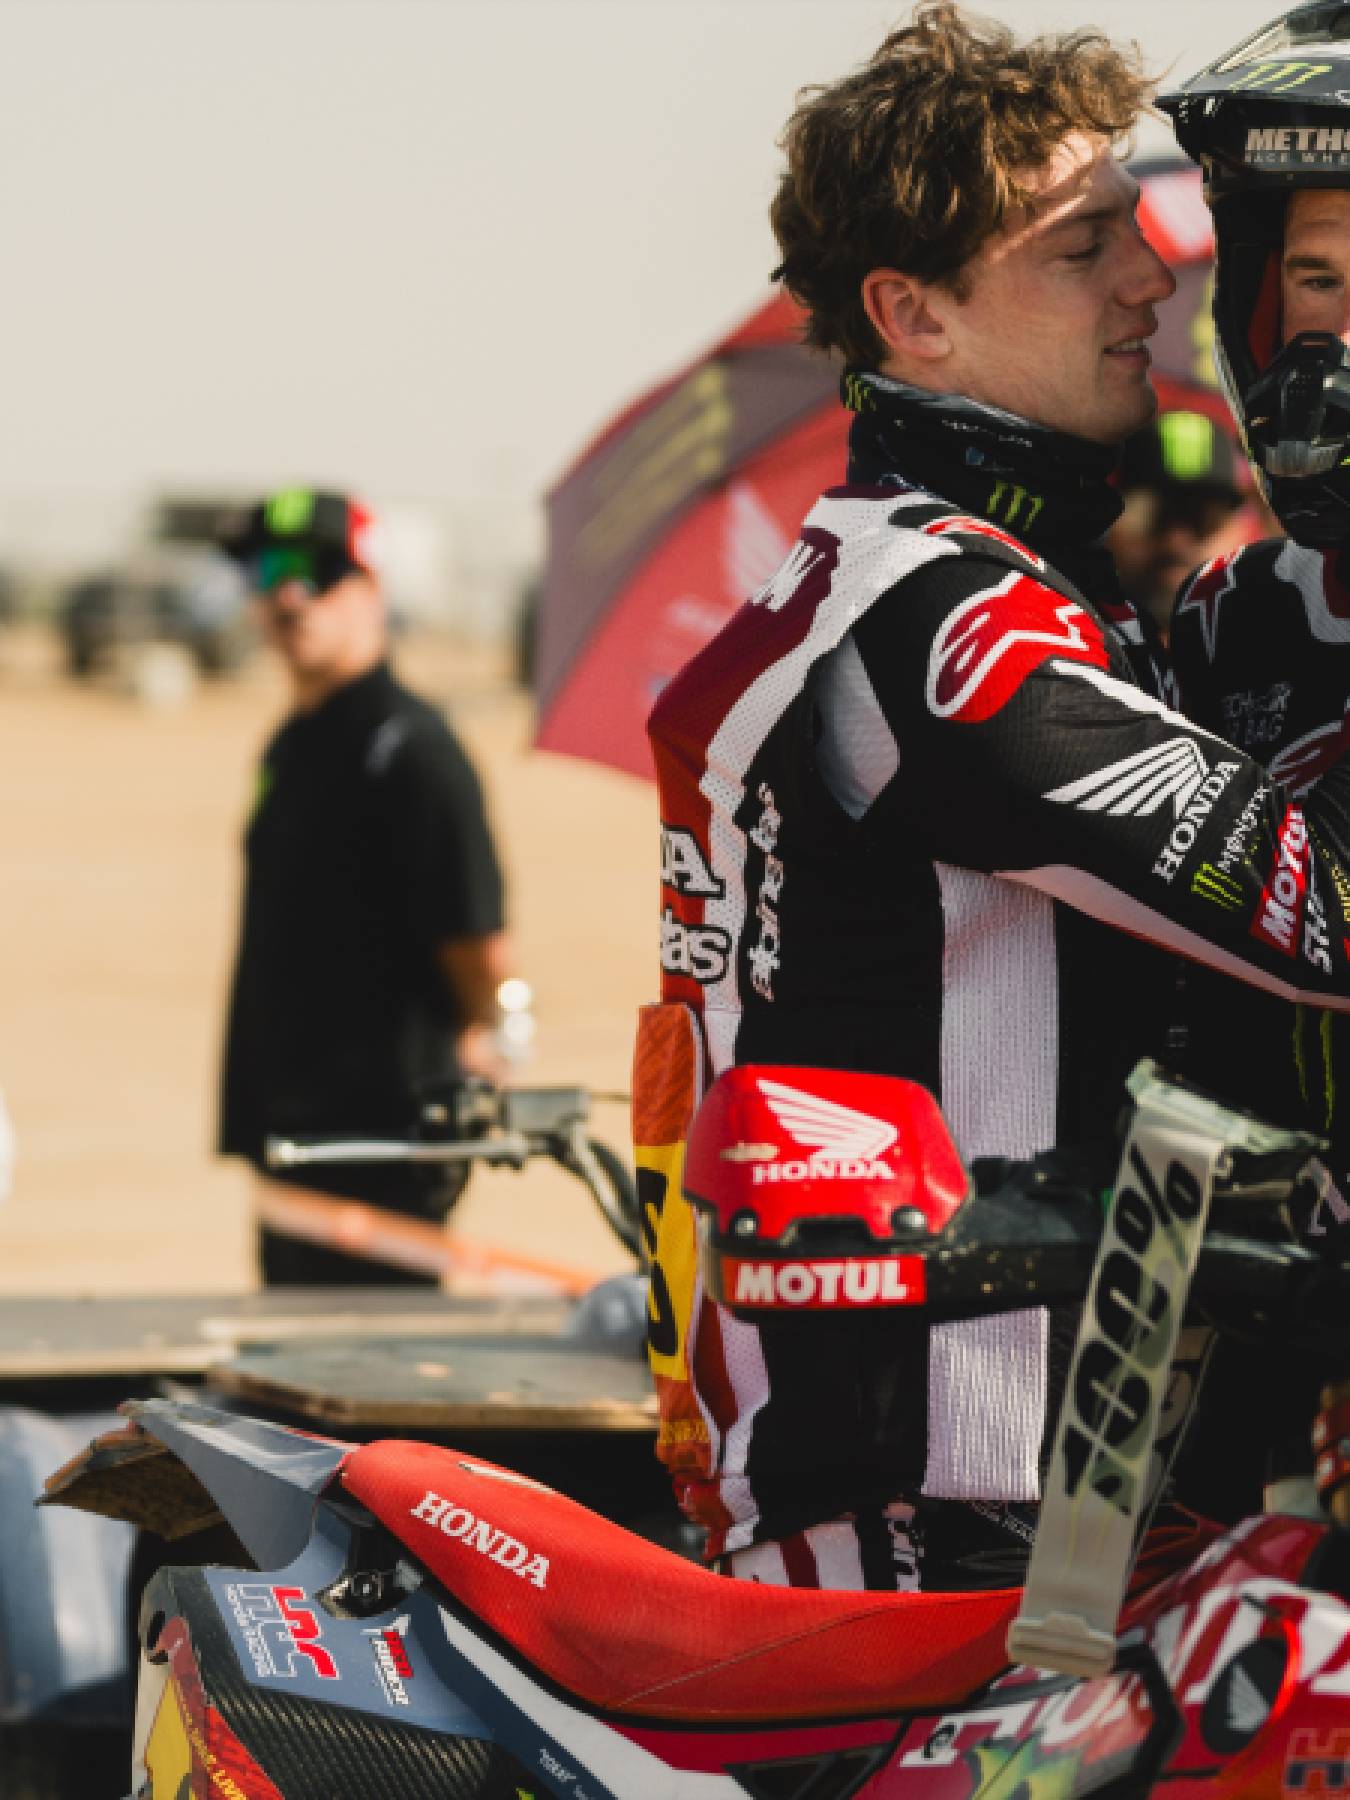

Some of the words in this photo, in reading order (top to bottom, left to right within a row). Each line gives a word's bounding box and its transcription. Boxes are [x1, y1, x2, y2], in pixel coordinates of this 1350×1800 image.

[1151, 761, 1241, 884] HONDA
[751, 1159, 897, 1185] HONDA
[735, 1259, 908, 1304] MOTUL
[409, 1490, 553, 1589] HONDA
[237, 1584, 340, 1679] HRC
